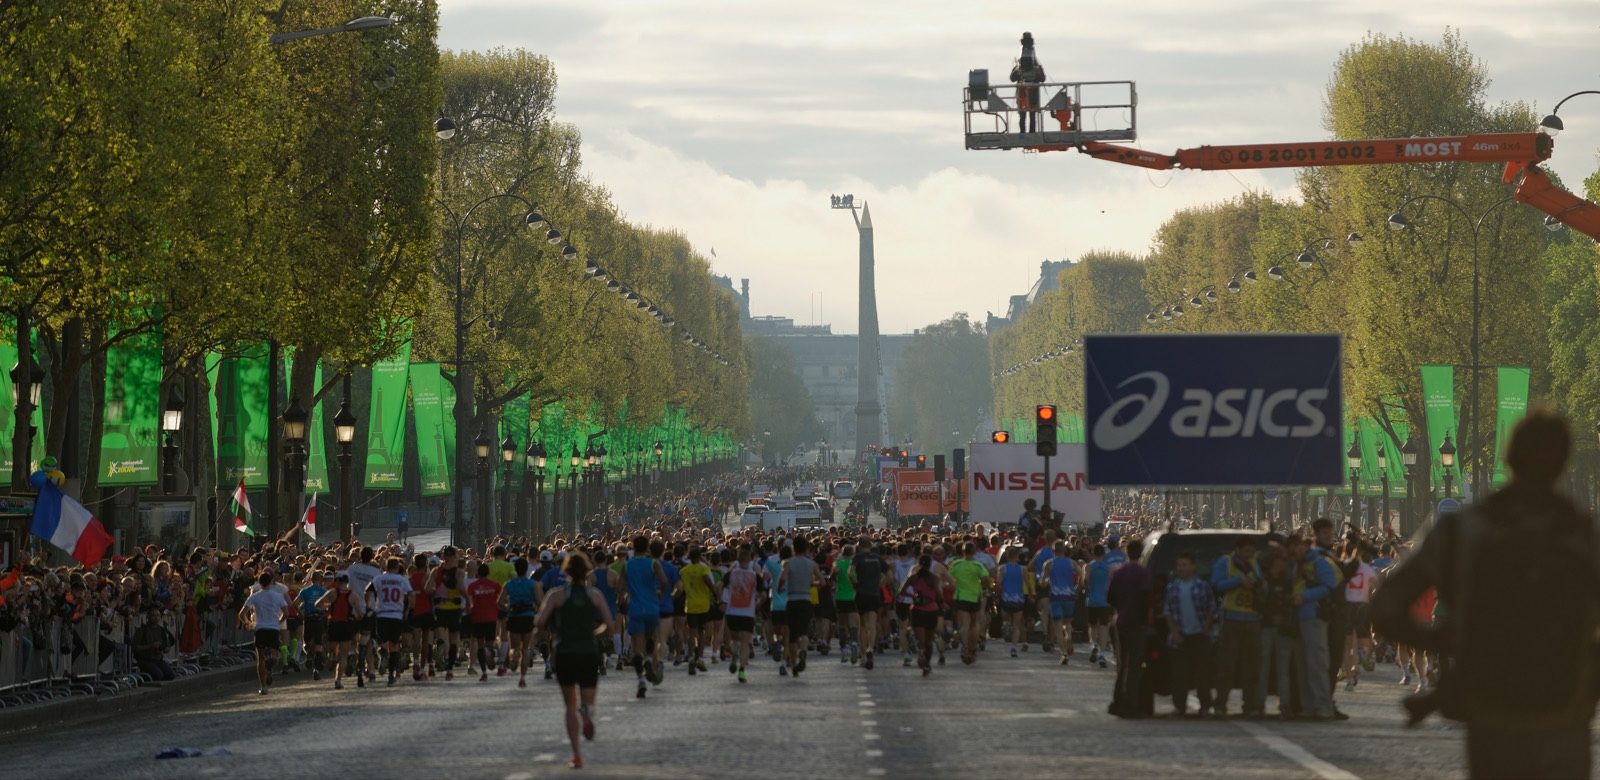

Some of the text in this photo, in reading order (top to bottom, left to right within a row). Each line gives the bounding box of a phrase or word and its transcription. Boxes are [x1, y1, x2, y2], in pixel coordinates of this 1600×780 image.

[1238, 145, 1376, 162] 08 2001 2002
[1404, 141, 1462, 157] MOST
[1472, 142, 1499, 151] 46m
[902, 485, 939, 493] PLANET
[381, 587, 402, 603] 10
